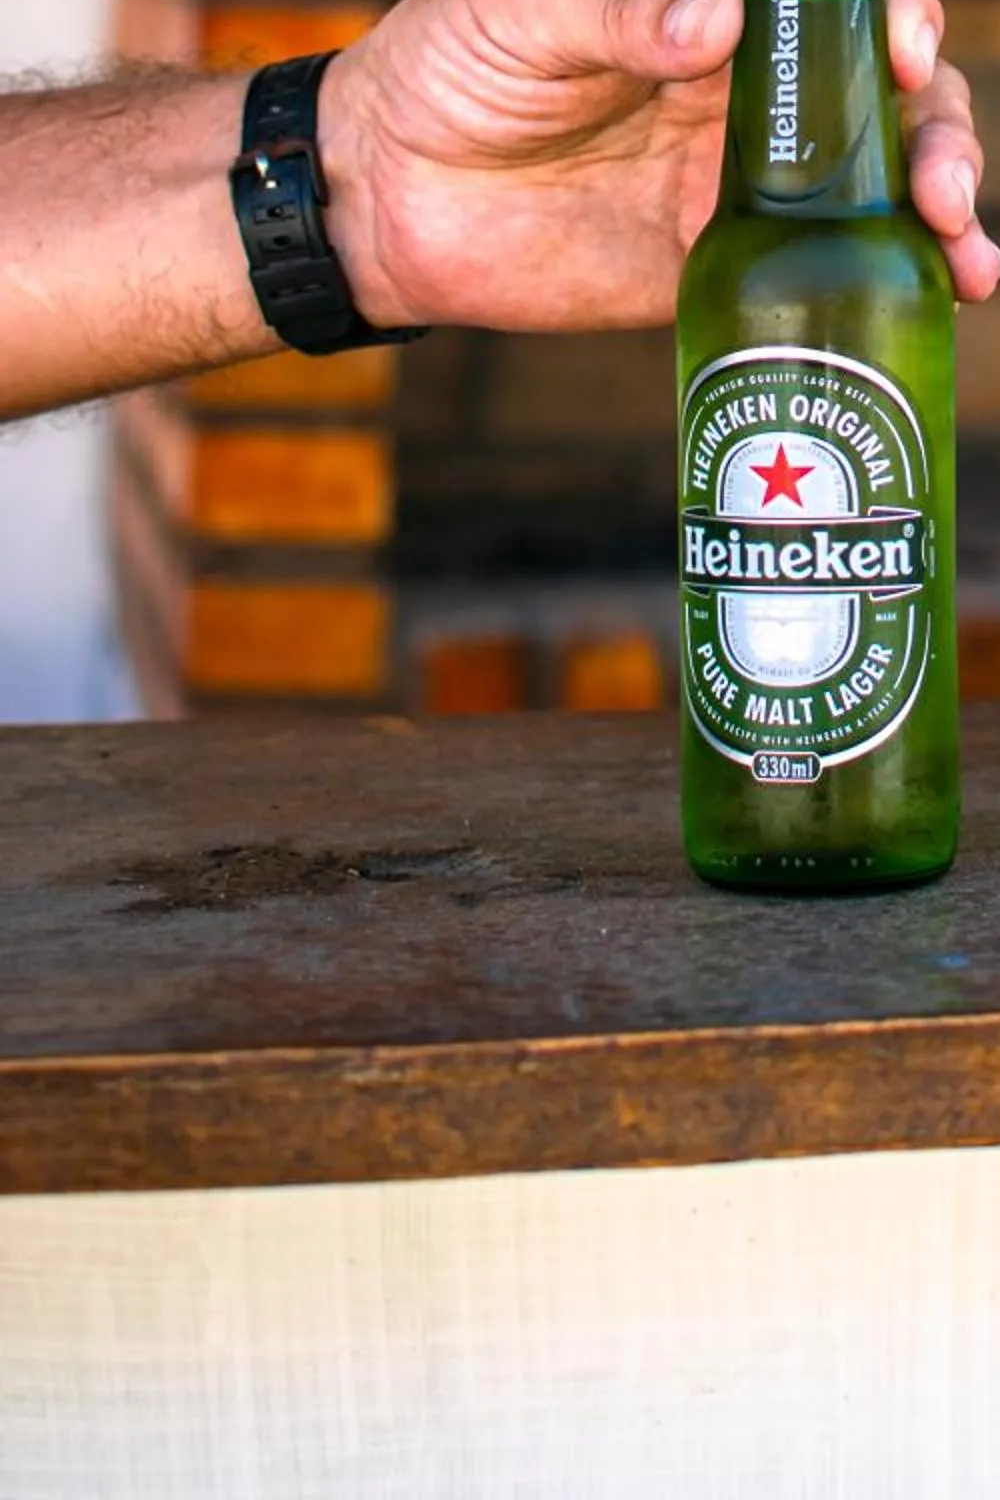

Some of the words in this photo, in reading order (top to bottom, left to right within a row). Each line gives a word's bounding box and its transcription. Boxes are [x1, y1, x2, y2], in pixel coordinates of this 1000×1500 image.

[692, 393, 778, 491] HEINEKEN
[789, 394, 895, 493] ORIGINAL
[684, 525, 914, 580] Heineken
[697, 643, 740, 709] PURE
[743, 693, 814, 726] MALT
[824, 643, 895, 717] LAGER
[758, 756, 814, 778] 330ml
